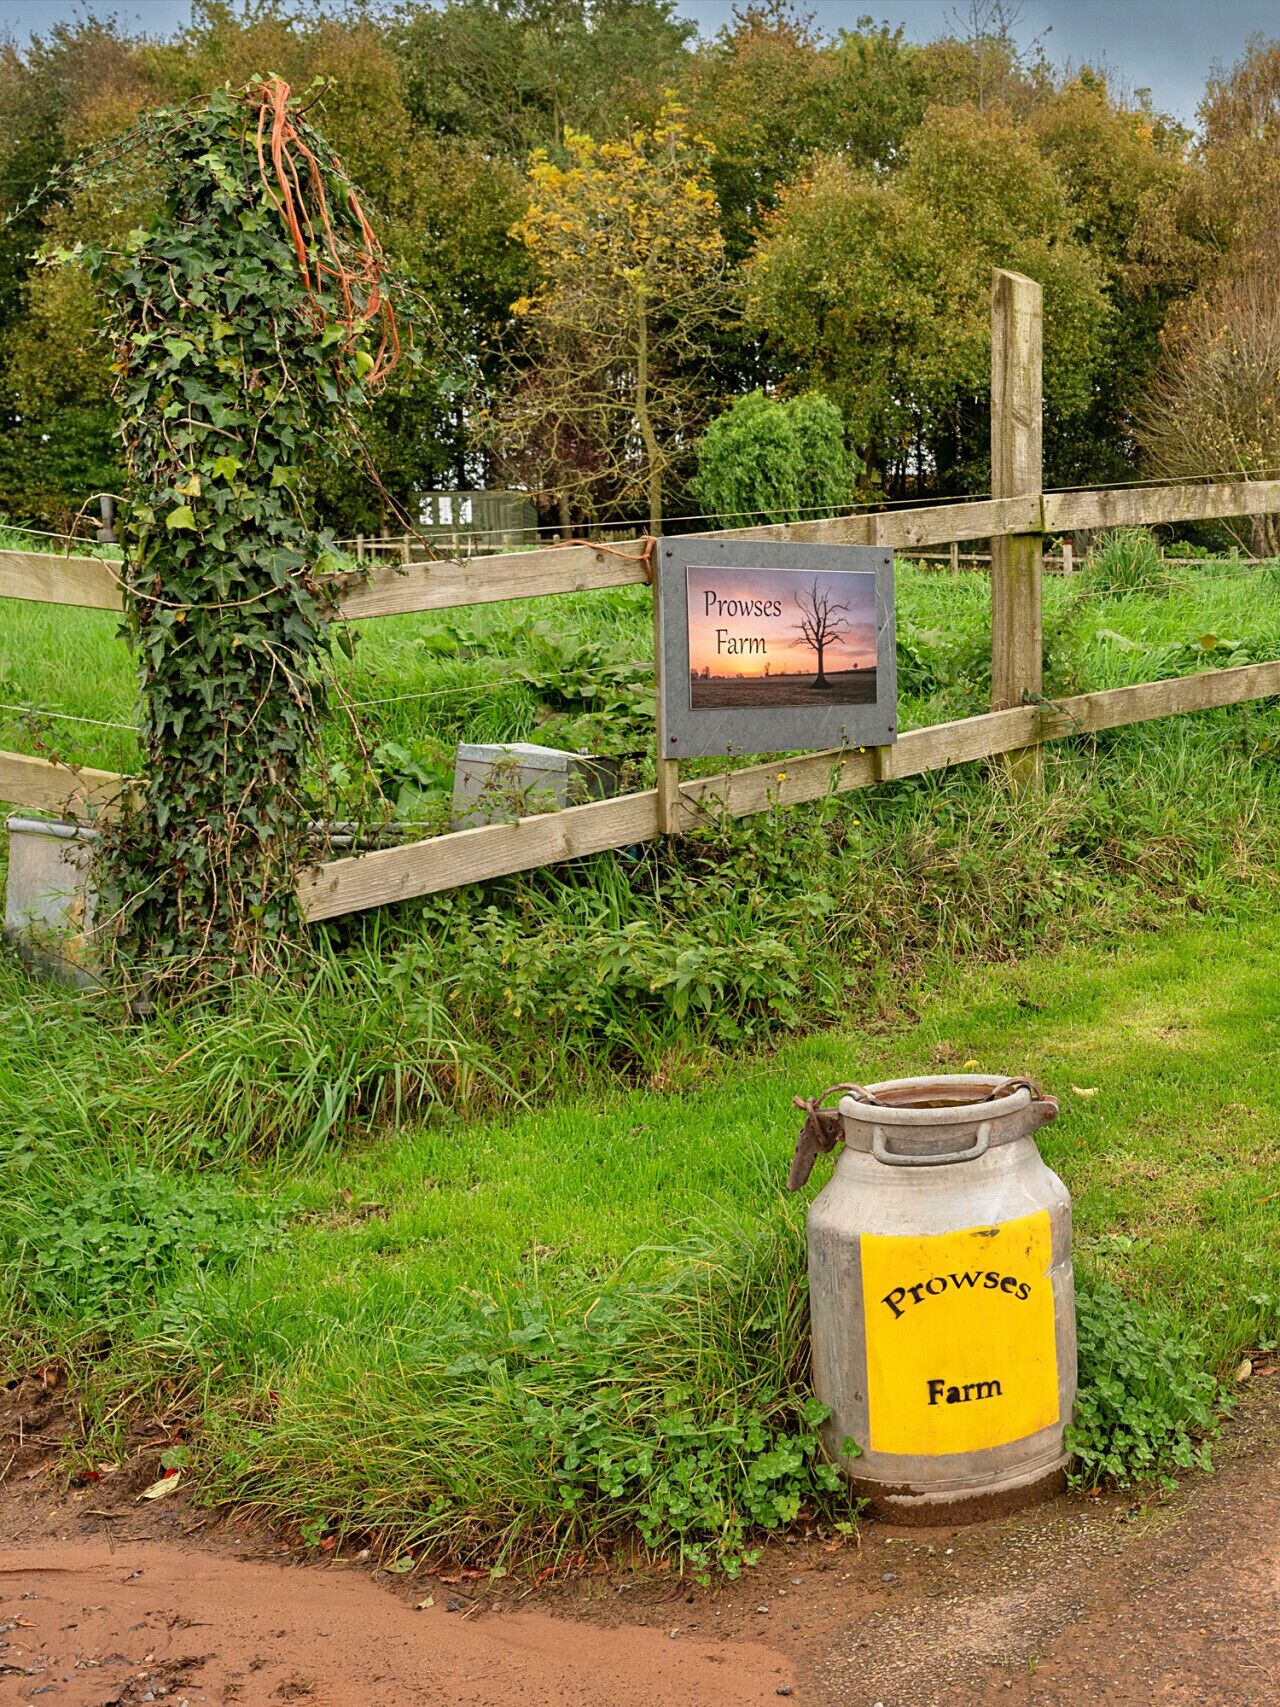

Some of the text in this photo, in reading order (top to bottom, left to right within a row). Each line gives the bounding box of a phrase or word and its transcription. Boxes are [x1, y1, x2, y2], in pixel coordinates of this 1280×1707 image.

[703, 590, 782, 617] Prowses
[715, 629, 767, 654] Farm
[881, 1271, 1032, 1320] Prowses
[927, 1379, 1003, 1405] Farm
